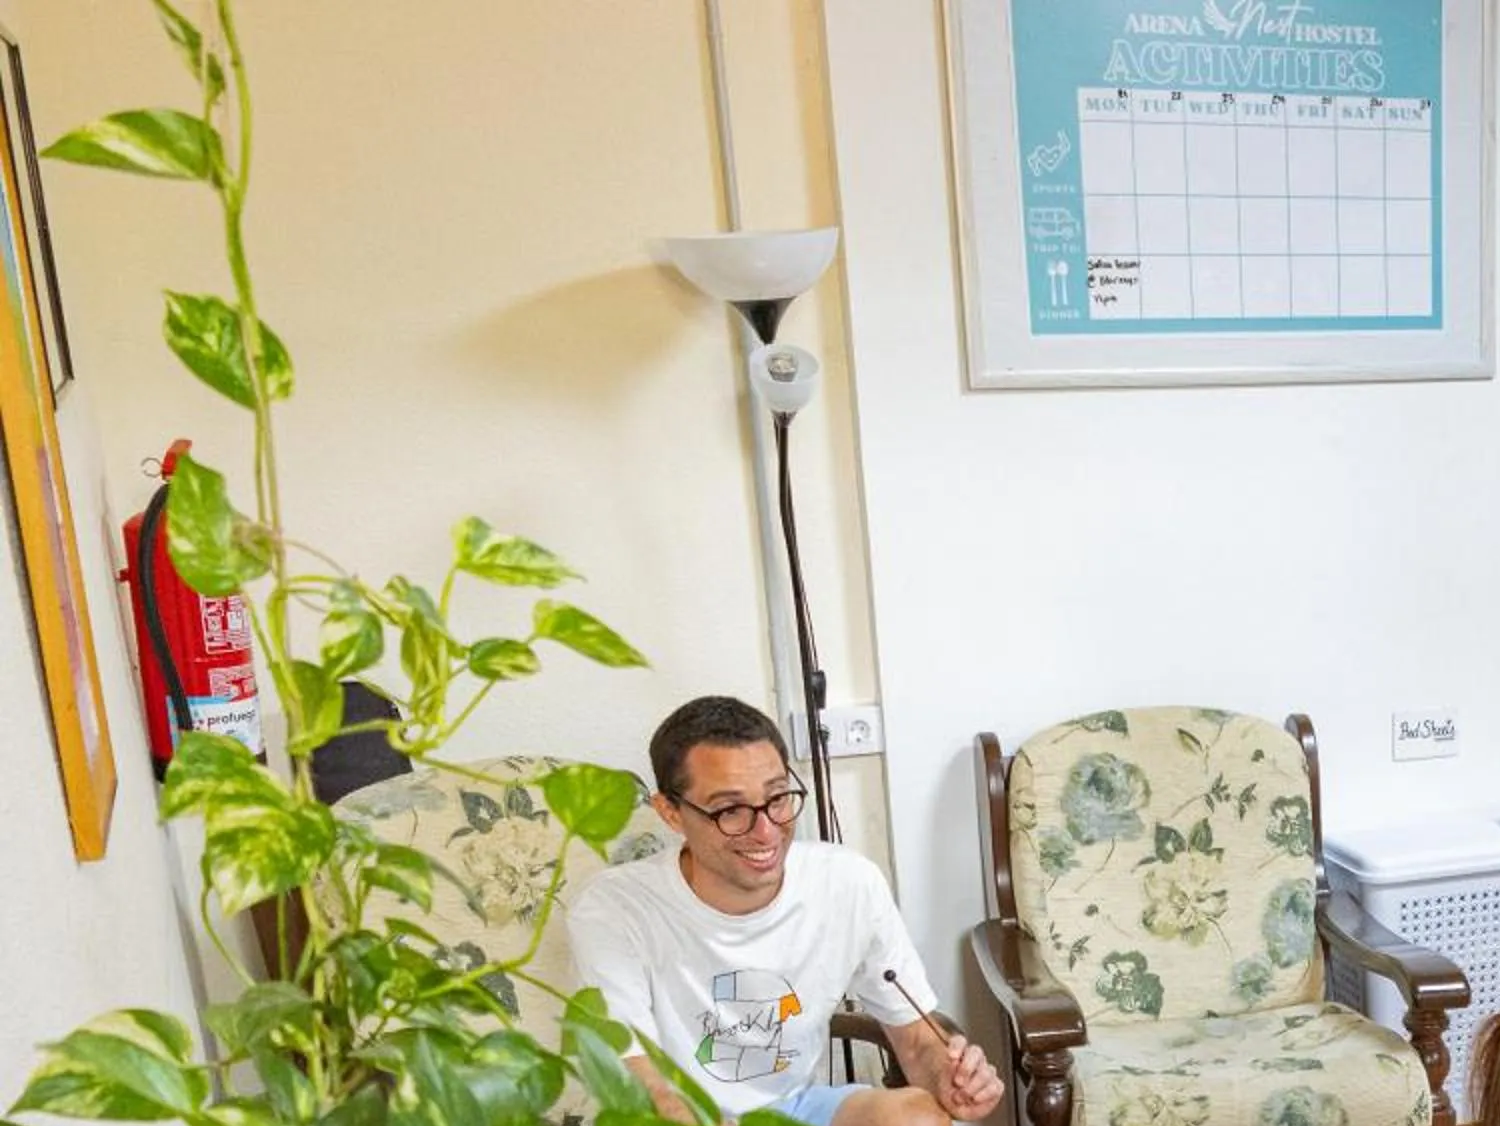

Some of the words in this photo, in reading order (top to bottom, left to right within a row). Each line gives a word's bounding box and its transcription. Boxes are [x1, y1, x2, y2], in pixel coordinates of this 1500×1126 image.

[1124, 13, 1205, 36] ARENA
[1295, 24, 1383, 46] HOSTEL
[1103, 38, 1385, 92] ACTIVITIES
[1085, 97, 1127, 112] MON
[1141, 98, 1177, 113] TUE
[1189, 100, 1229, 115] WED
[1243, 102, 1279, 117] THU
[1297, 104, 1328, 118] FRI
[1342, 106, 1377, 119] SAT
[1388, 107, 1424, 121] SUN
